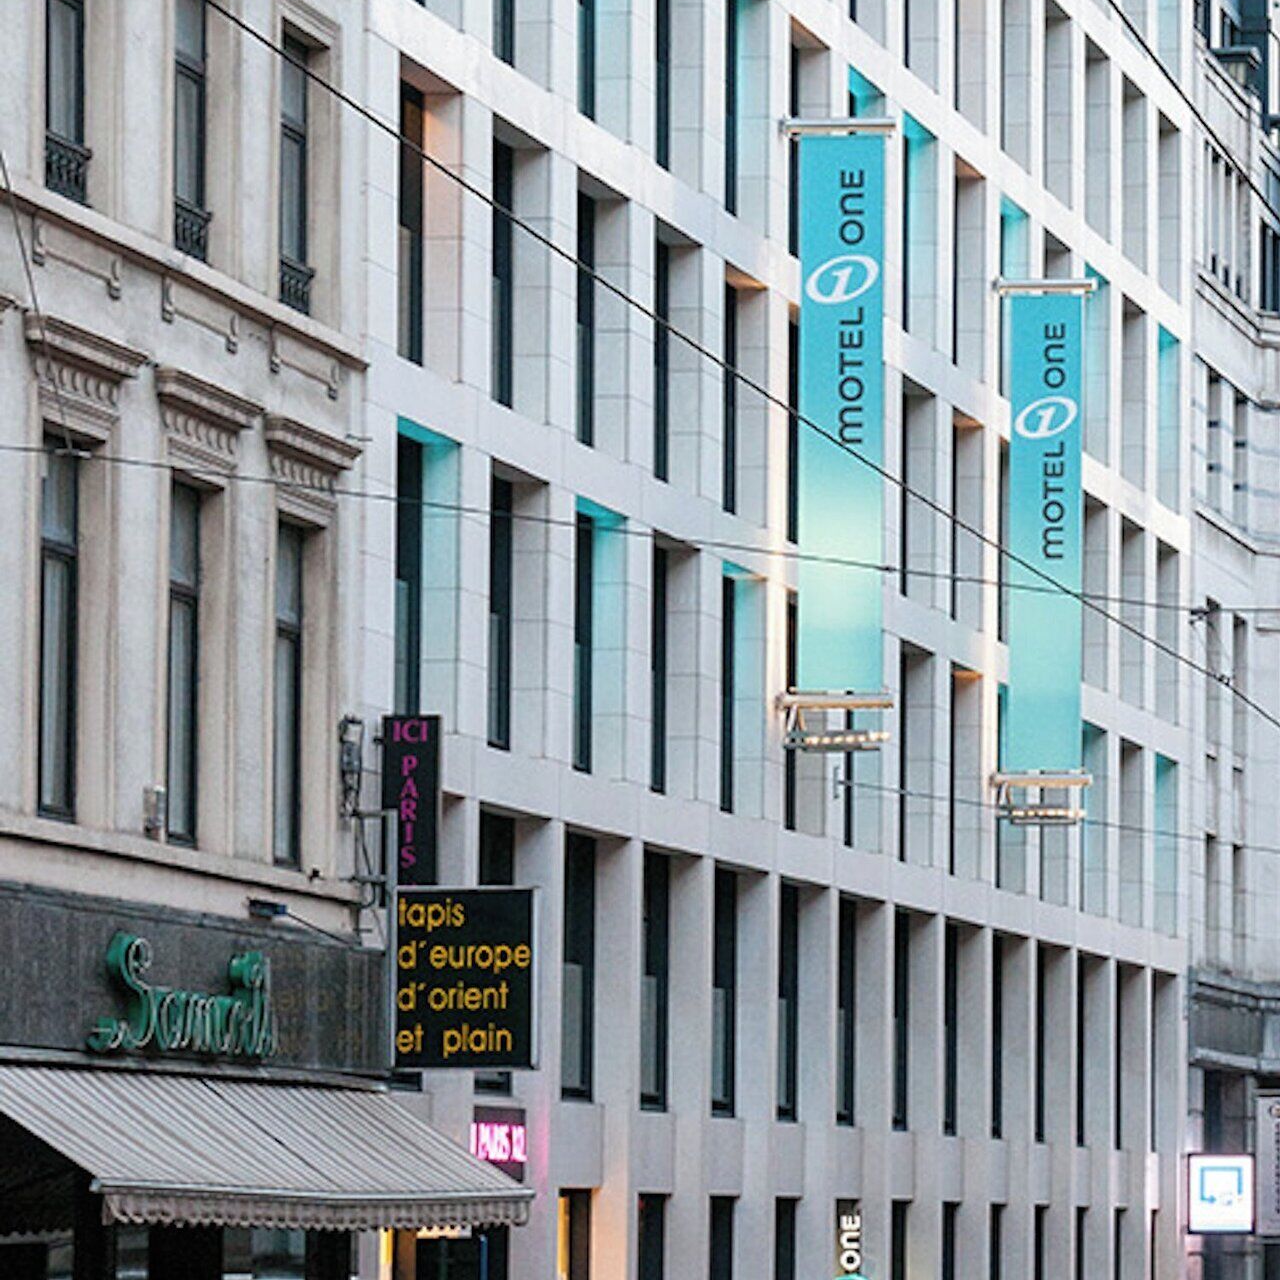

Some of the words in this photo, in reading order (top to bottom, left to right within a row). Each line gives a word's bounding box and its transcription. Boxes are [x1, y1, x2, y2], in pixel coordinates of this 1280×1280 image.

[392, 721, 428, 743] ICI
[399, 755, 419, 868] PARIS
[398, 897, 466, 933] tapis
[397, 941, 532, 974] d'europe
[397, 980, 510, 1012] d'orient
[395, 1023, 424, 1054] et
[442, 1023, 514, 1059] plain
[839, 1215, 861, 1271] ONE
